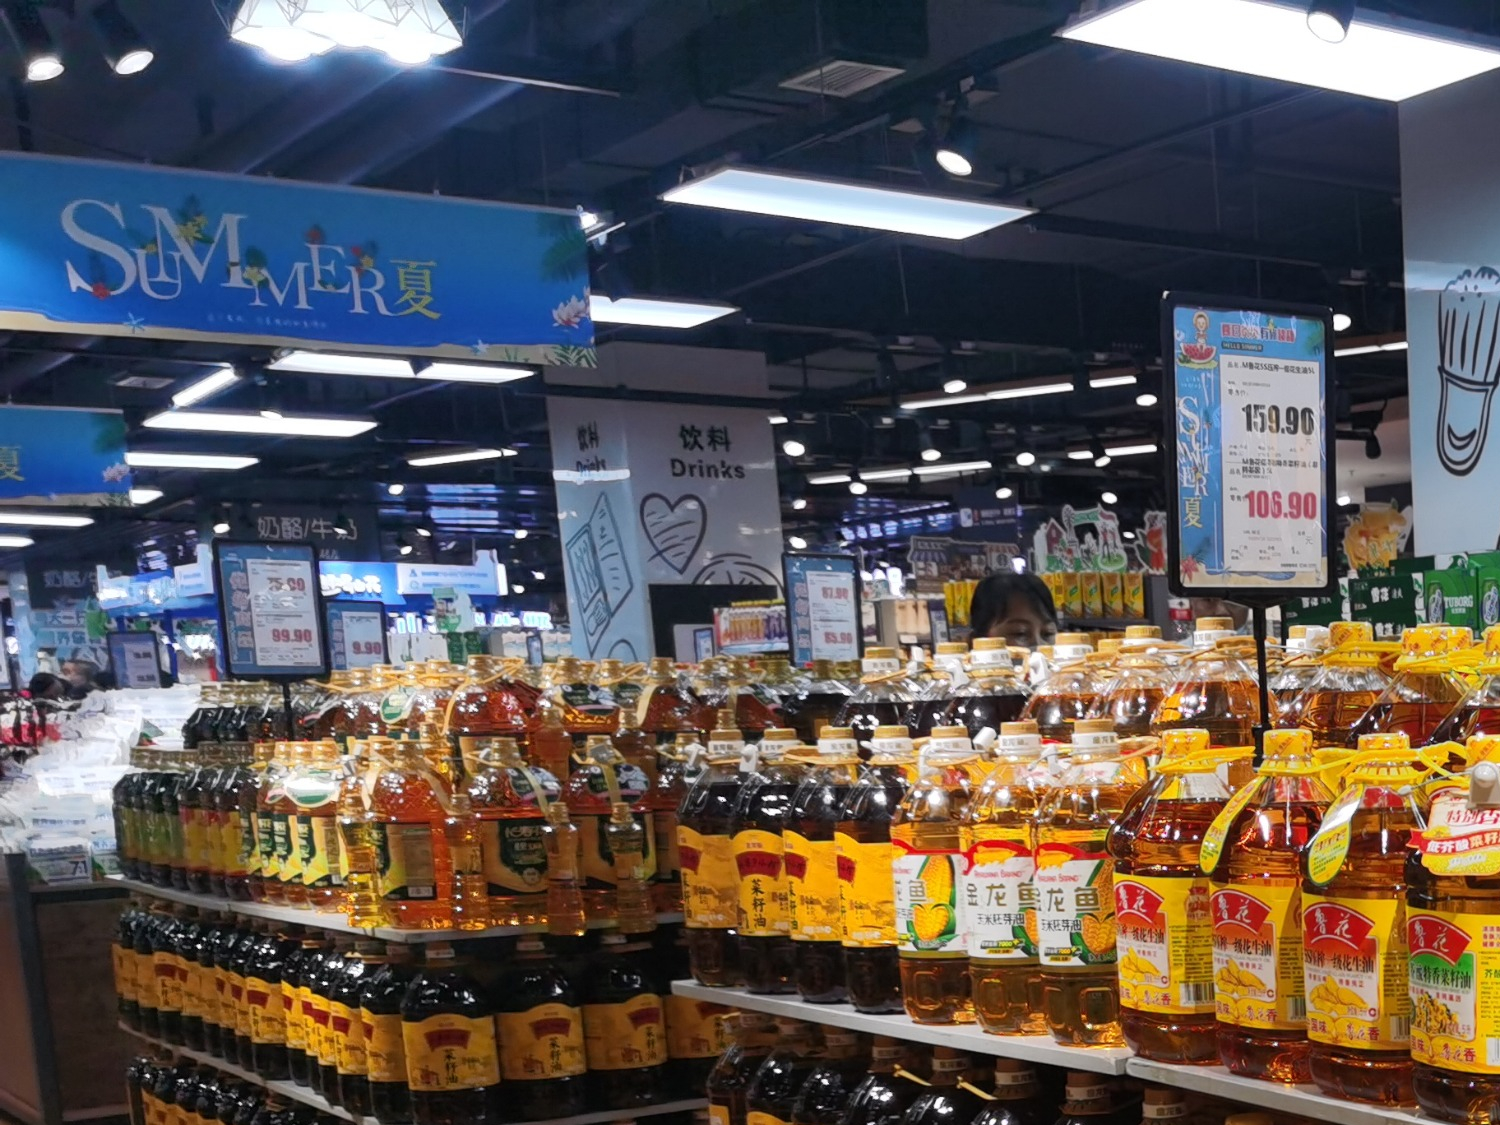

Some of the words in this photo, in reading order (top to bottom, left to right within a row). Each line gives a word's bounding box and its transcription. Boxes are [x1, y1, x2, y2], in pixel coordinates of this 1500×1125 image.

[60, 199, 401, 317] SUMMER
[389, 259, 441, 319] 夏
[1242, 404, 1314, 436] 159.90
[679, 423, 732, 452] 饮料
[670, 457, 746, 479] Drinks
[1183, 496, 1203, 528] 夏
[1245, 490, 1317, 520] 106.90
[1444, 595, 1474, 607] TUBORG
[272, 628, 312, 643] 99.90
[352, 641, 381, 655] 9.90
[750, 878, 768, 930] 菜籽油
[1218, 894, 1252, 924] 鲁花
[977, 914, 1025, 926] 玉米胚芽油
[1313, 908, 1353, 939] 鲁花
[1413, 920, 1450, 953] 鲁花
